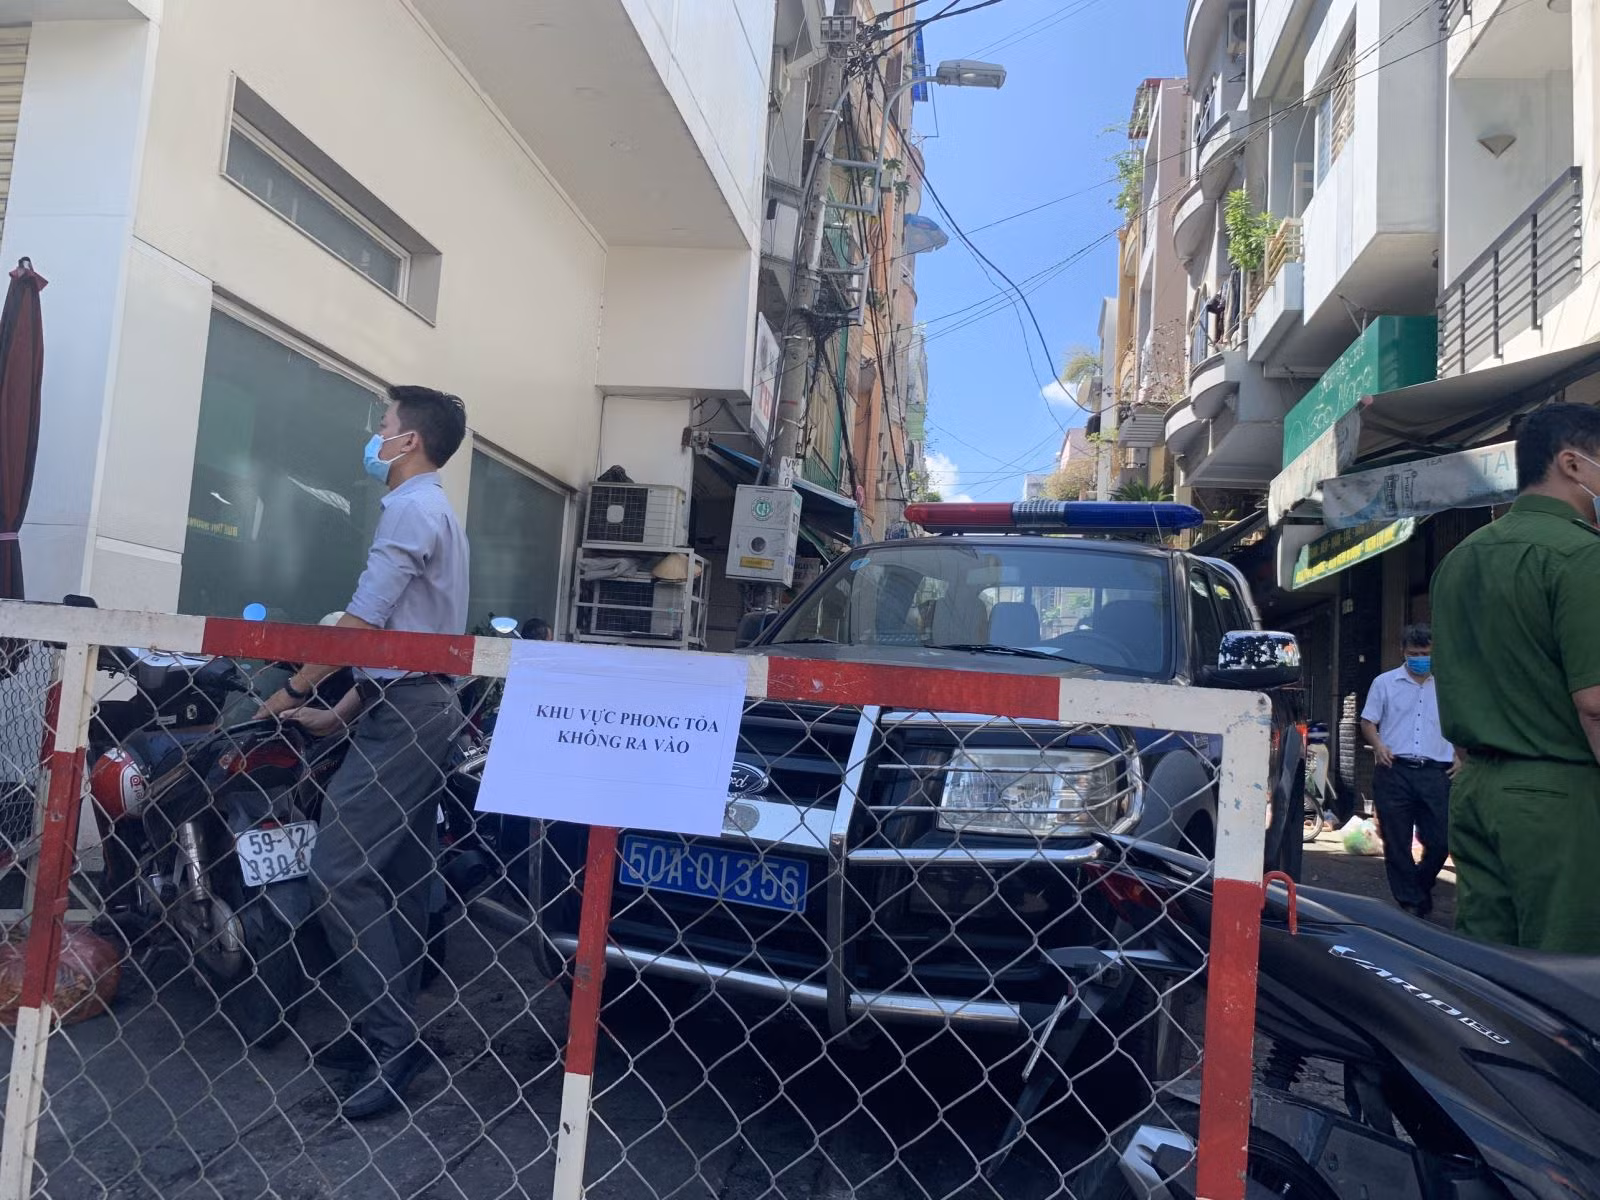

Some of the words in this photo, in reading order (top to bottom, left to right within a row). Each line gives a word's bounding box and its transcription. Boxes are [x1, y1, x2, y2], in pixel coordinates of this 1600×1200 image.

[536, 704, 575, 720] KHU
[580, 708, 617, 726] VỰC
[620, 712, 680, 730] PHONG
[557, 729, 622, 749] KHÔNG
[625, 736, 648, 751] RA
[654, 735, 691, 754] VÀO
[627, 841, 800, 905] 50A-013.56
[1327, 944, 1462, 1016] VARIO
